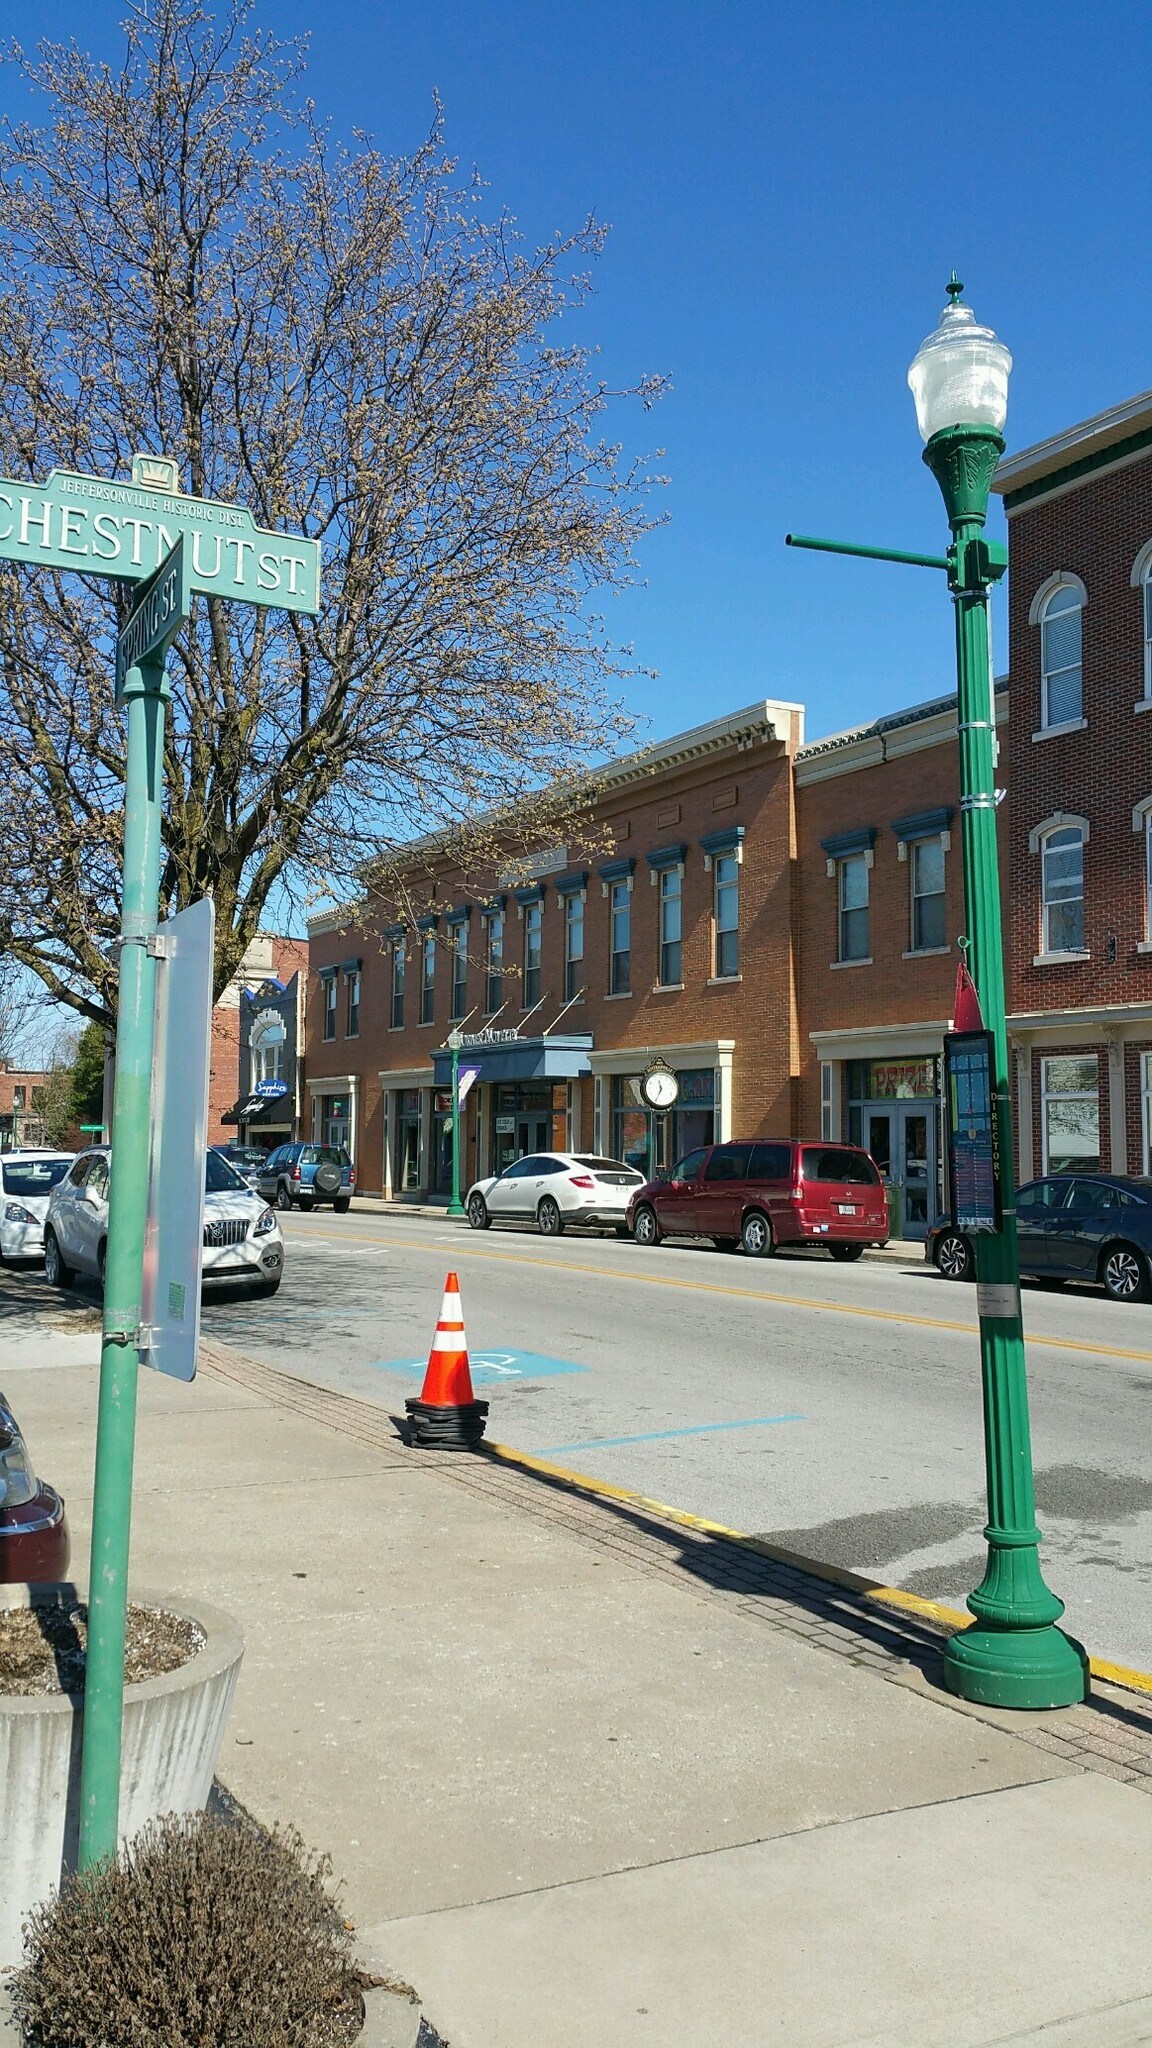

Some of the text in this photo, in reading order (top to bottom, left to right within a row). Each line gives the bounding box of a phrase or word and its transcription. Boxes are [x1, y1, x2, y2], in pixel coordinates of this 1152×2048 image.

[59, 480, 246, 529] JEFFERSONVILLE HISTORIC DIST.
[257, 553, 307, 596] ST.
[121, 568, 178, 682] SPRING ST.
[990, 1092, 1001, 1181] DIRECTORY
